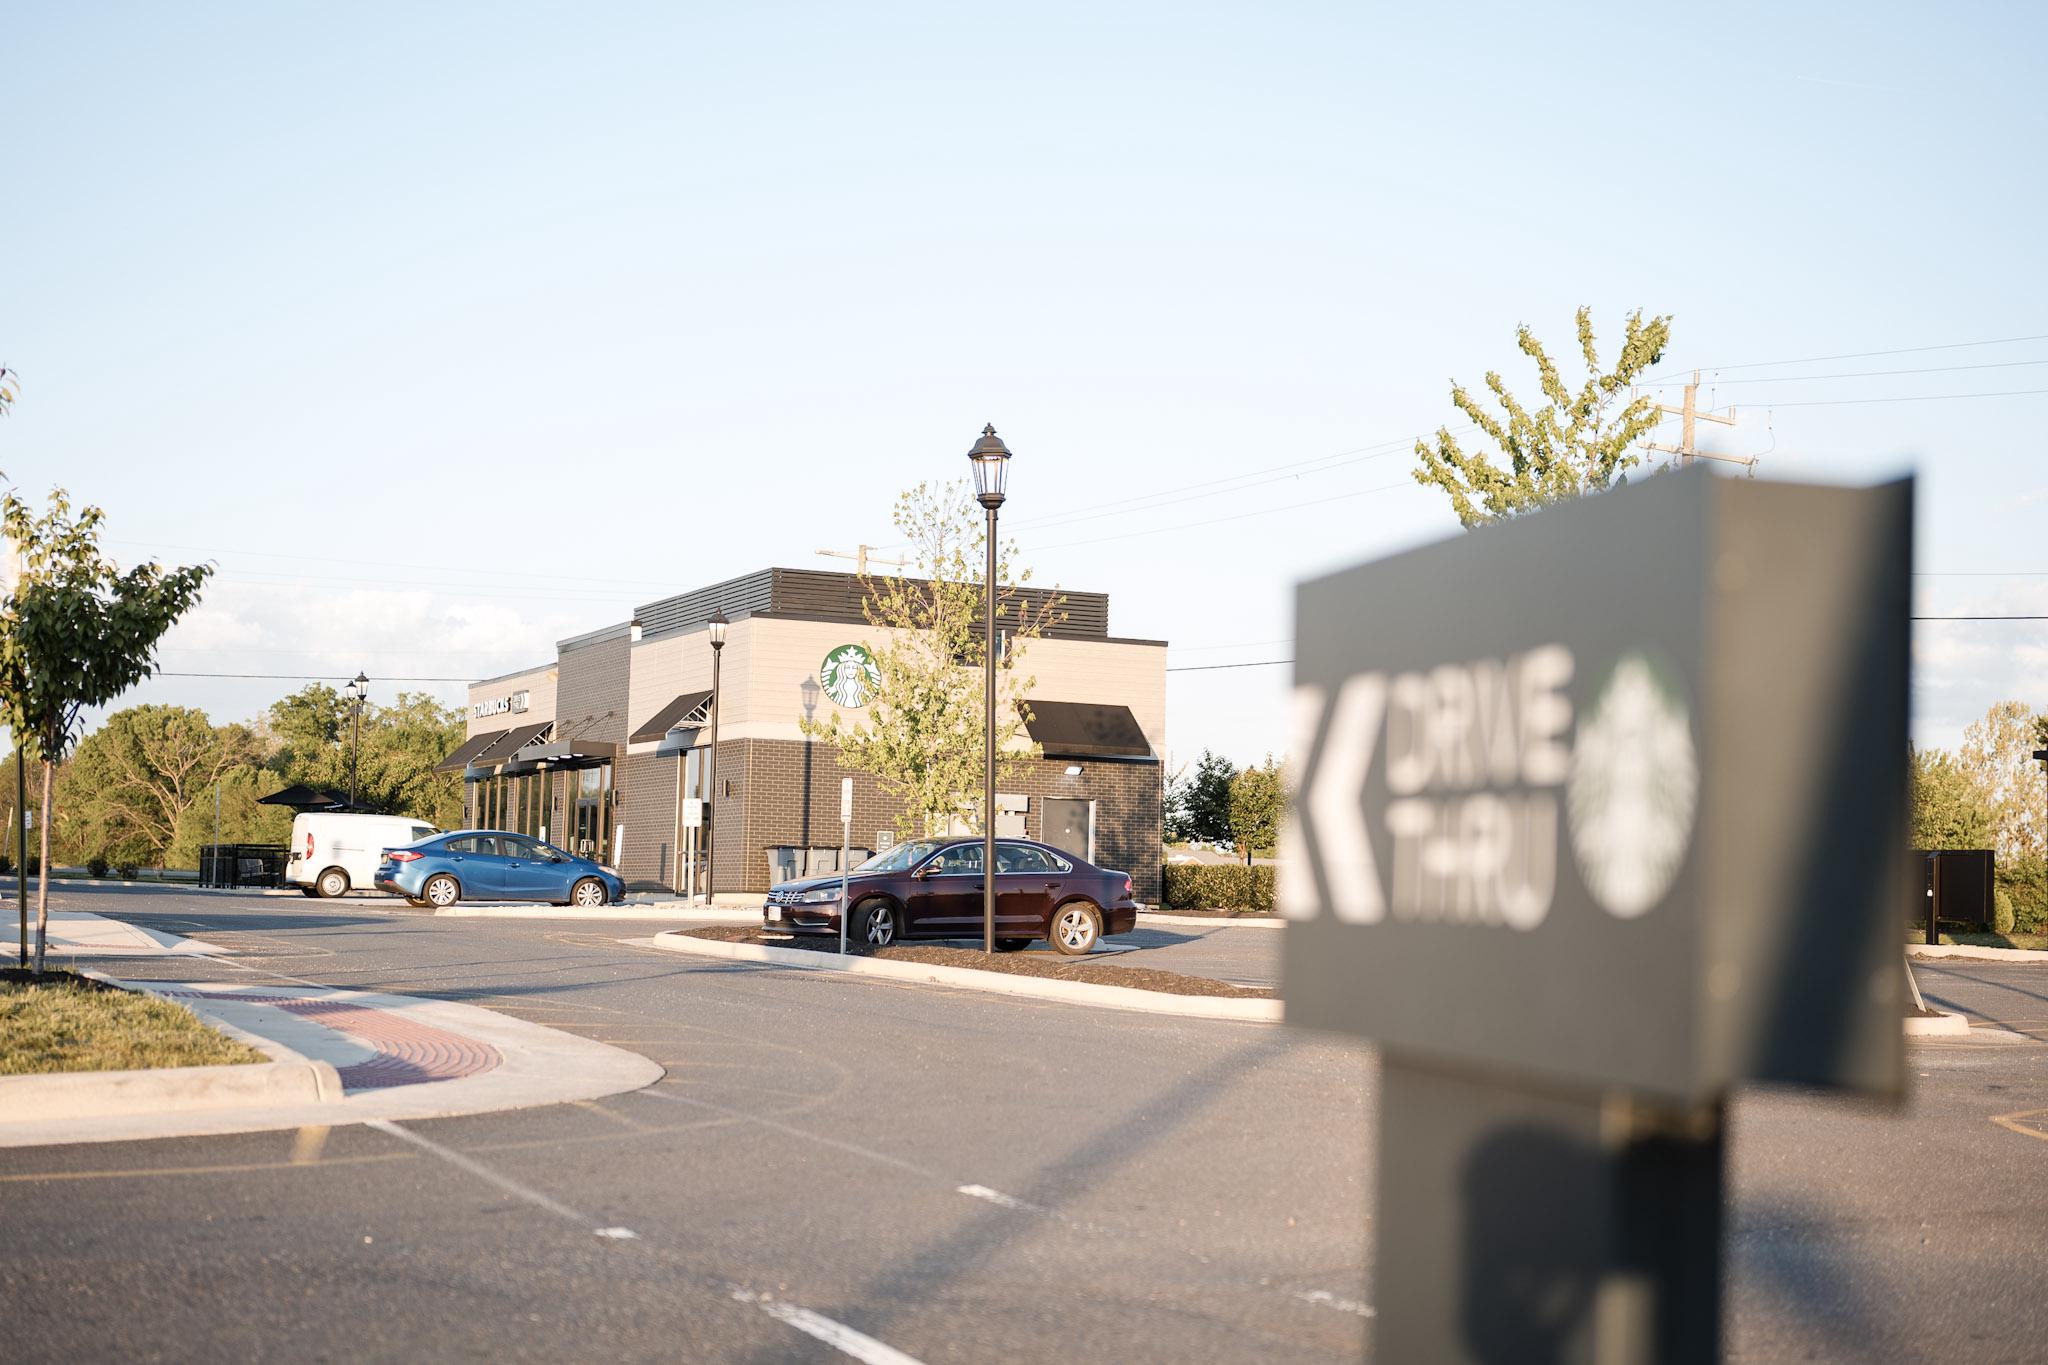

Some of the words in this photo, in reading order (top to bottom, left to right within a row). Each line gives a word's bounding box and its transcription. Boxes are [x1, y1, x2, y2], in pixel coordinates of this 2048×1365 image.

[474, 697, 511, 718] STARBUCKS
[1385, 643, 1575, 795] DRIVE
[1384, 793, 1558, 930] THRU
